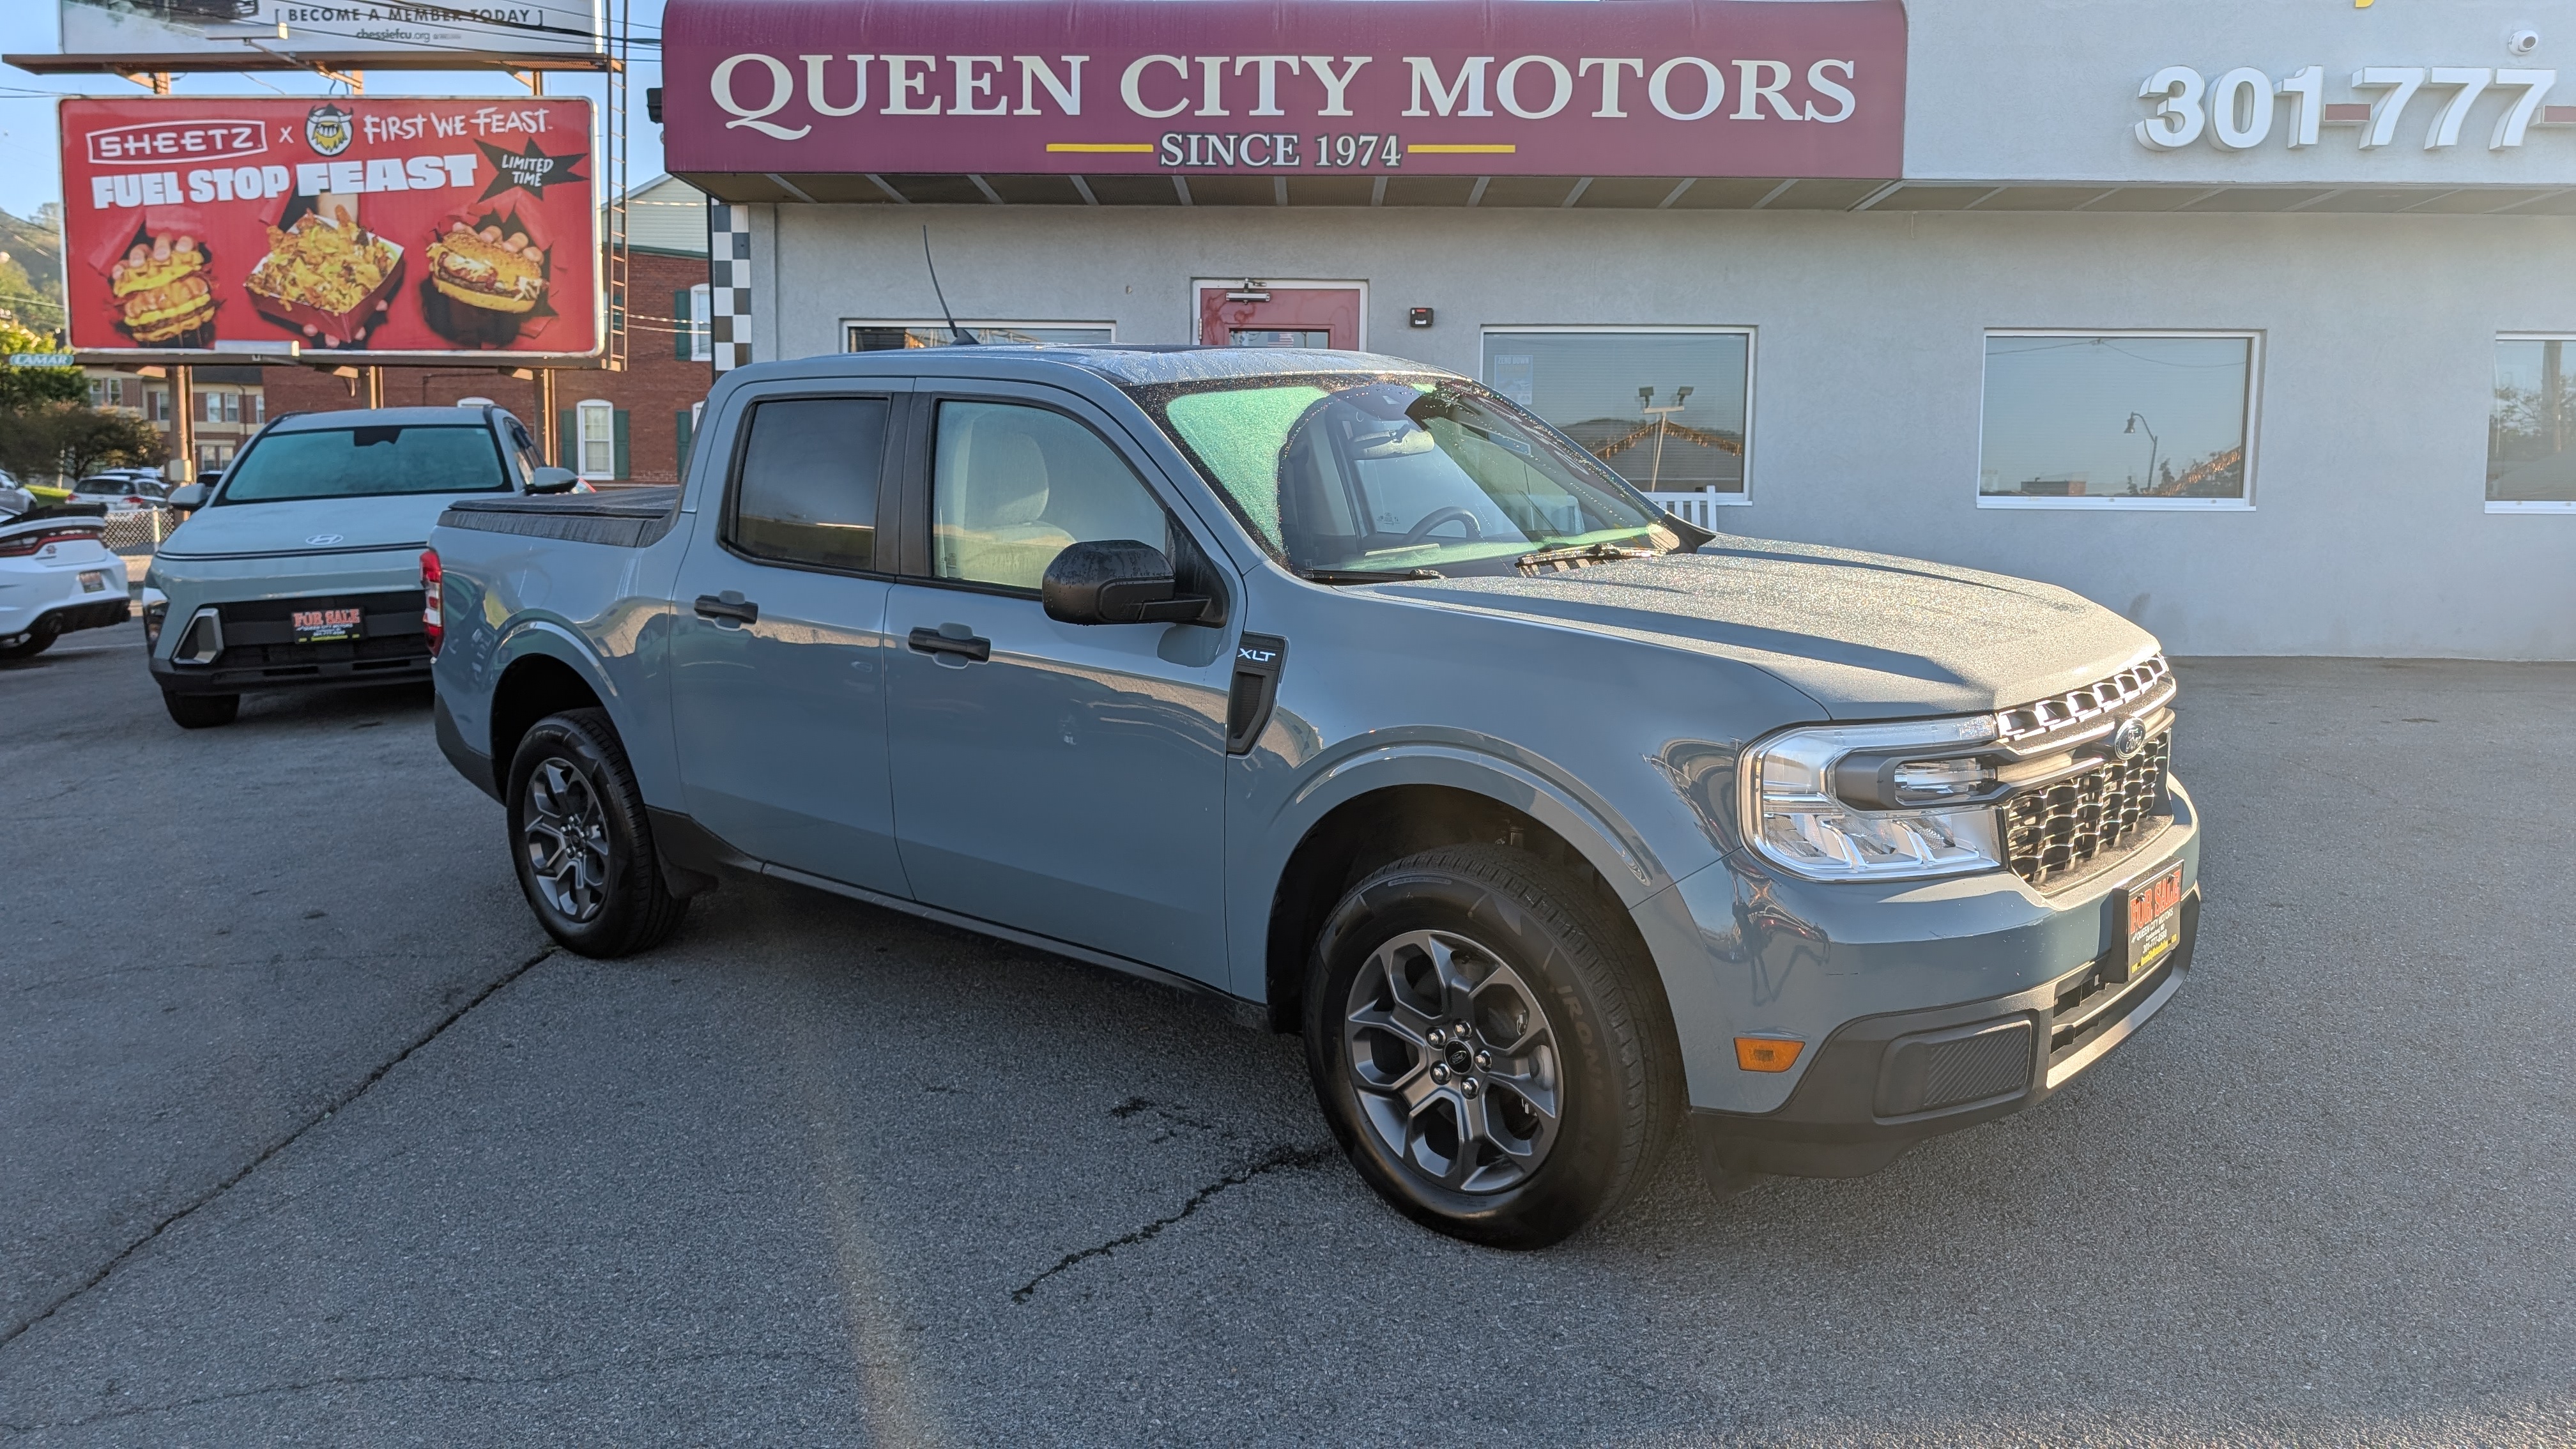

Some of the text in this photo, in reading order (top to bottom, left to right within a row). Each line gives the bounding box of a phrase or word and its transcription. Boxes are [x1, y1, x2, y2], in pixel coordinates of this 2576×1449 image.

[289, 8, 360, 21] BECOME
[368, 8, 380, 21] A
[470, 9, 530, 22] TODAY
[710, 53, 1857, 141] QUEEN CITY MOTORS
[99, 126, 254, 157] SHEETZ
[362, 106, 550, 144] FIRST WE FEAST
[1160, 132, 1402, 168] SINCE 1974
[91, 153, 479, 210] FUEL STOP FEAST
[502, 154, 554, 187] LIMITED TIME
[13, 354, 68, 365] LAMAR
[1498, 356, 1529, 365] ZERO DOWN
[293, 608, 361, 627] FOR SALE
[1238, 648, 1276, 662] XLT
[2129, 869, 2181, 935] FOR SALE
[2136, 907, 2174, 941] QUEEN CITY MOTORS
